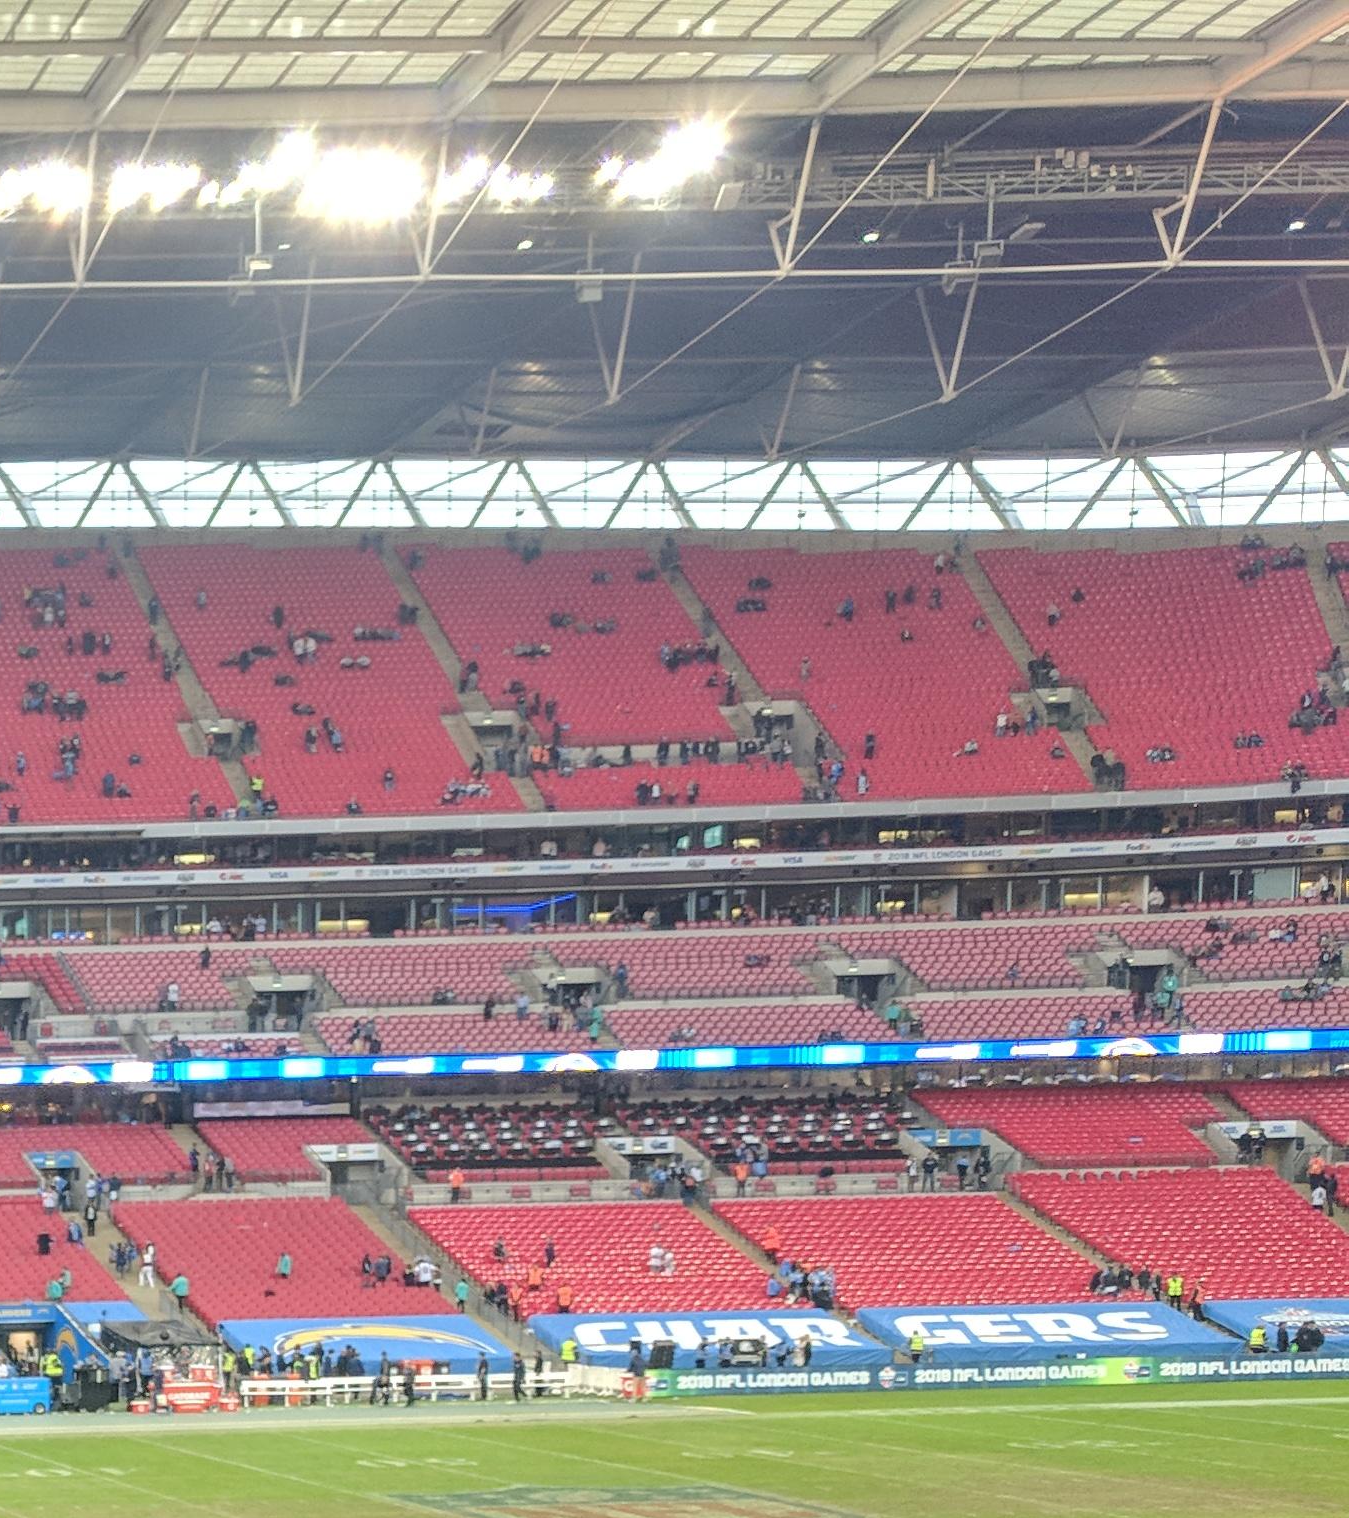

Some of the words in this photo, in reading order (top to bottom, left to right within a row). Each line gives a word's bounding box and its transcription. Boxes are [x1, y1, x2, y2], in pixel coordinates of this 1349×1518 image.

[573, 1316, 863, 1352] CHAR
[894, 1310, 1169, 1345] GERS
[914, 1368, 949, 1384] 2018
[951, 1367, 982, 1383] NFL
[984, 1365, 1046, 1382] LONDON
[1048, 1364, 1106, 1379] GAMES
[1159, 1361, 1197, 1377] 2018
[1199, 1360, 1229, 1376] NFL
[1230, 1359, 1292, 1374] LONDON
[1293, 1357, 1349, 1373] GAMES
[677, 1374, 714, 1390] 2018
[714, 1373, 746, 1389] NFL
[747, 1372, 808, 1388] LONDON
[810, 1371, 870, 1387] GAMES
